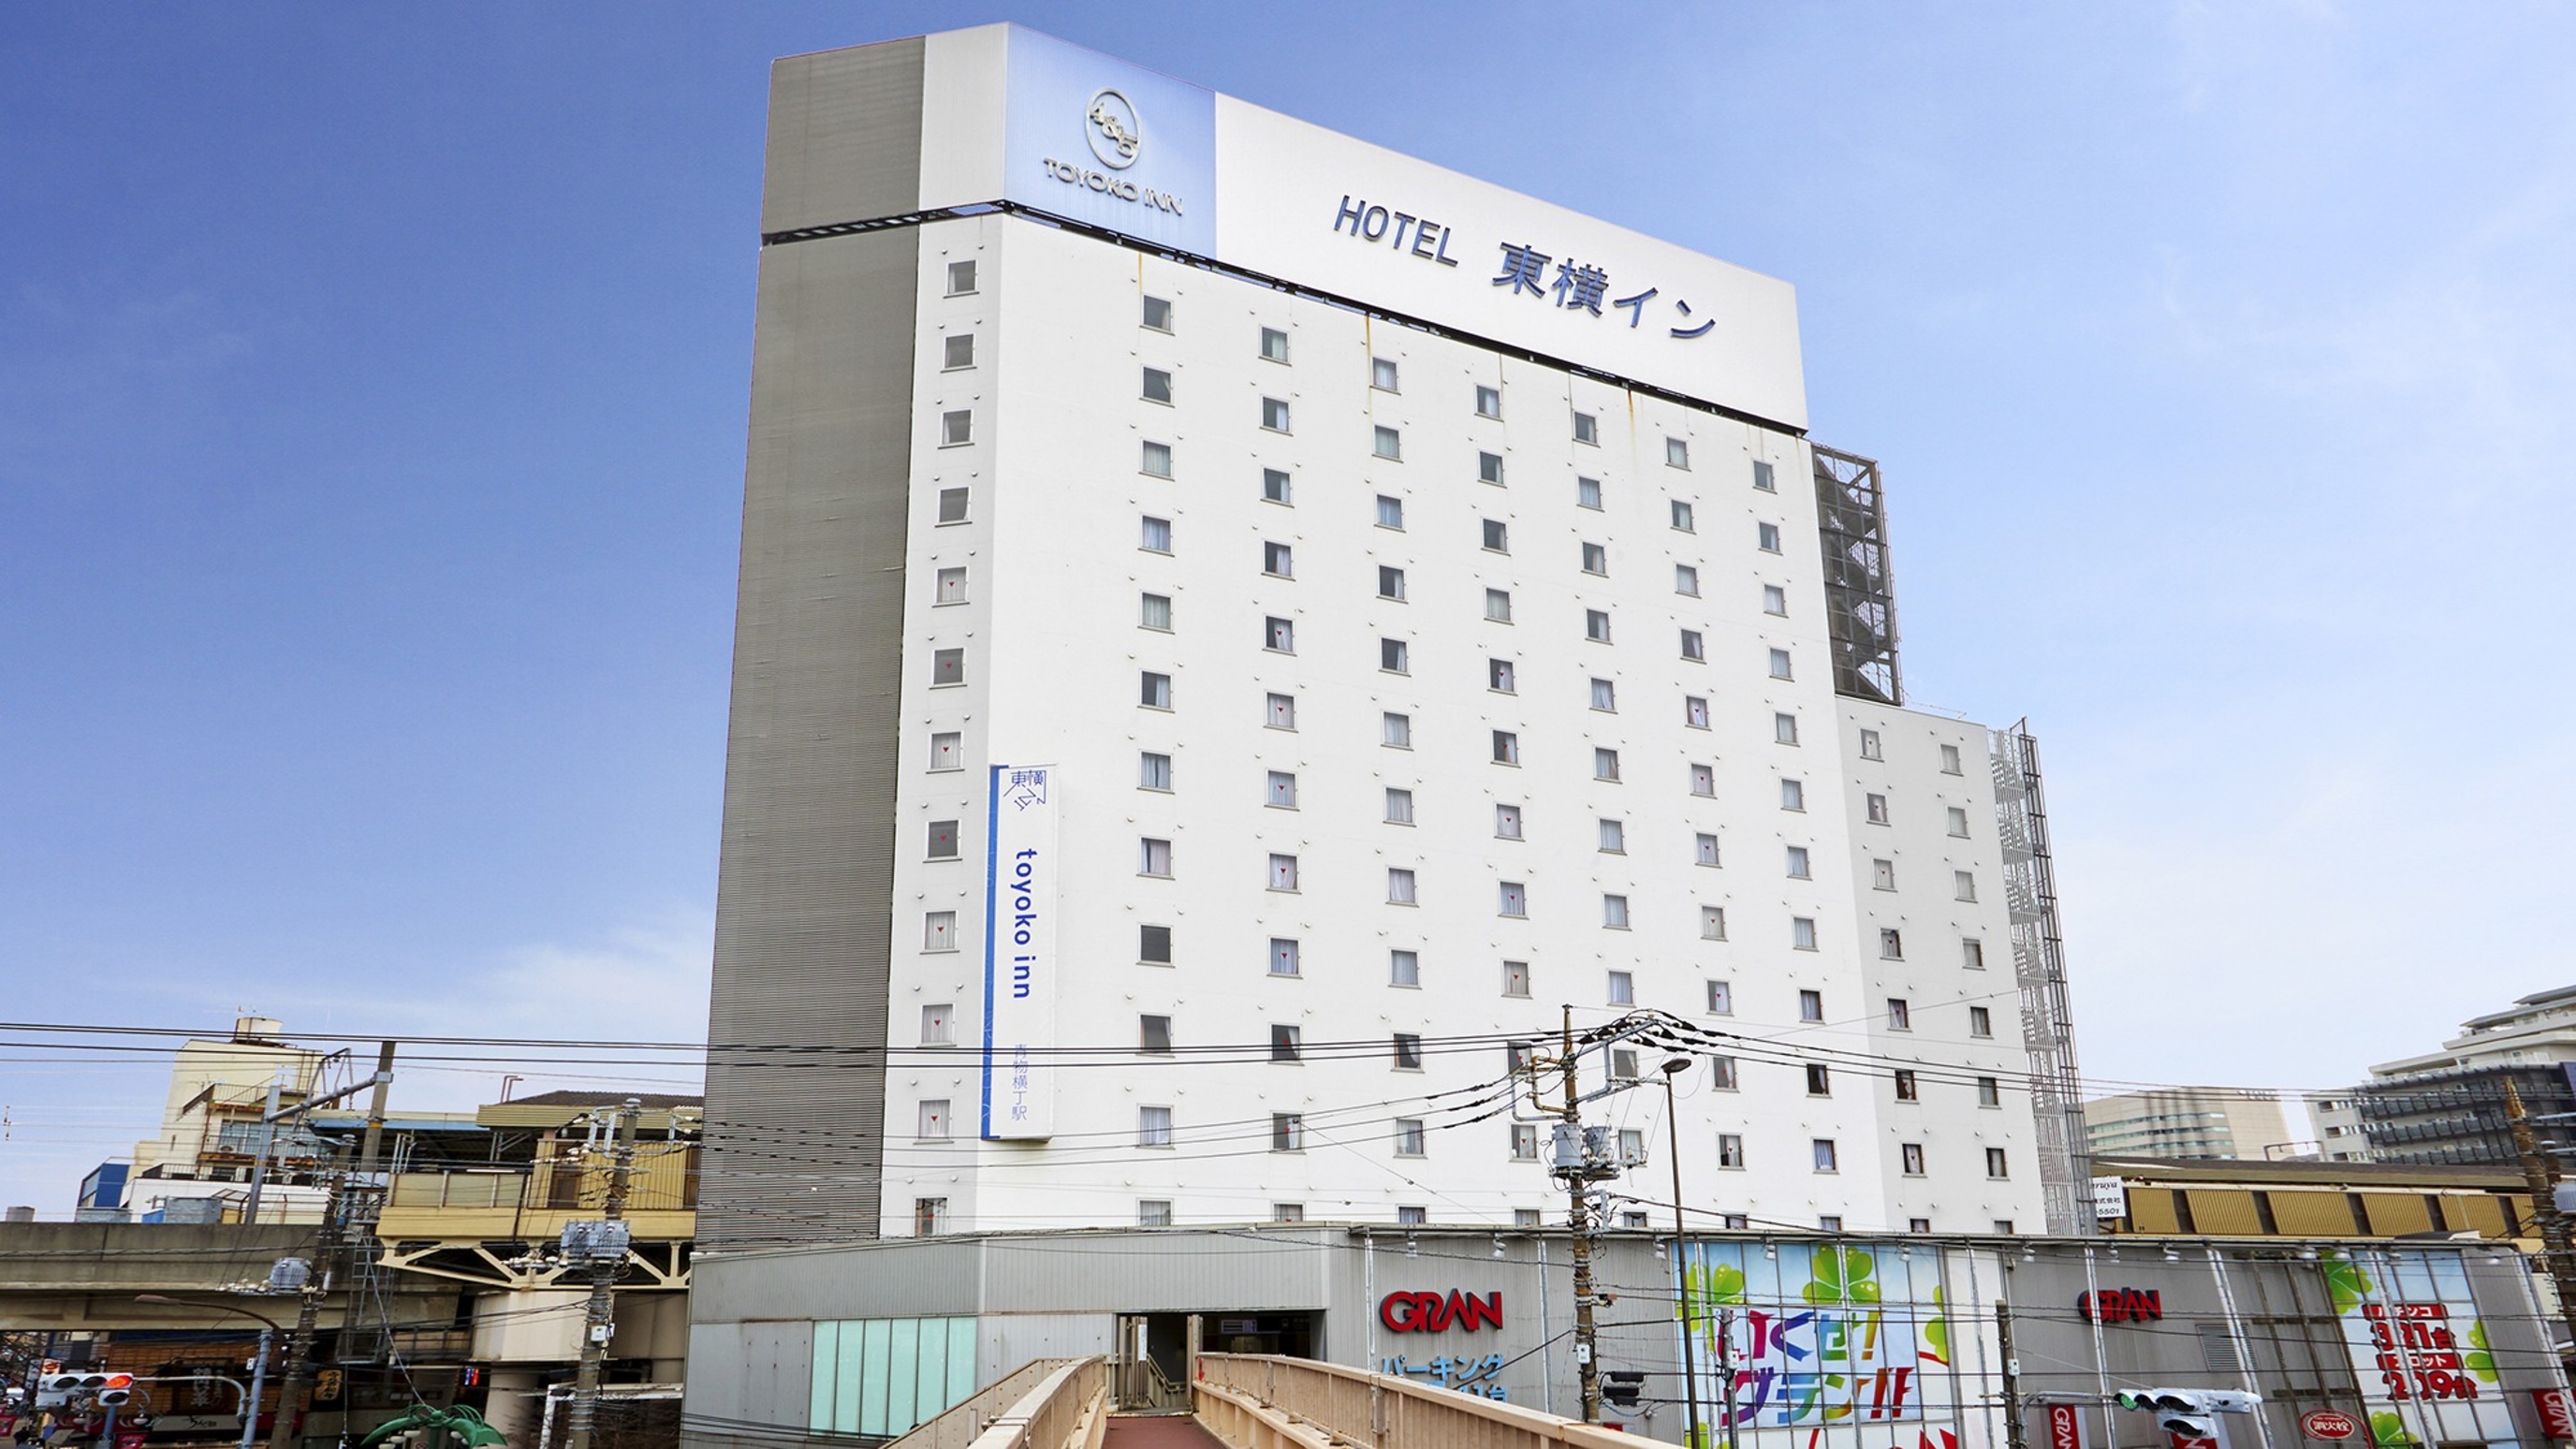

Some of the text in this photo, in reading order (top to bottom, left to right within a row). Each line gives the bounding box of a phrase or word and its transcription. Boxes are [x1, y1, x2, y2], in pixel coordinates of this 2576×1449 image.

[1044, 157, 1183, 217] TOYOKO INN
[1333, 194, 1717, 339] HOTEL 東横イン
[1010, 848, 1038, 999] toyoko inn
[1379, 1288, 1503, 1333] GRAN
[1382, 1354, 1505, 1381] パーキング
